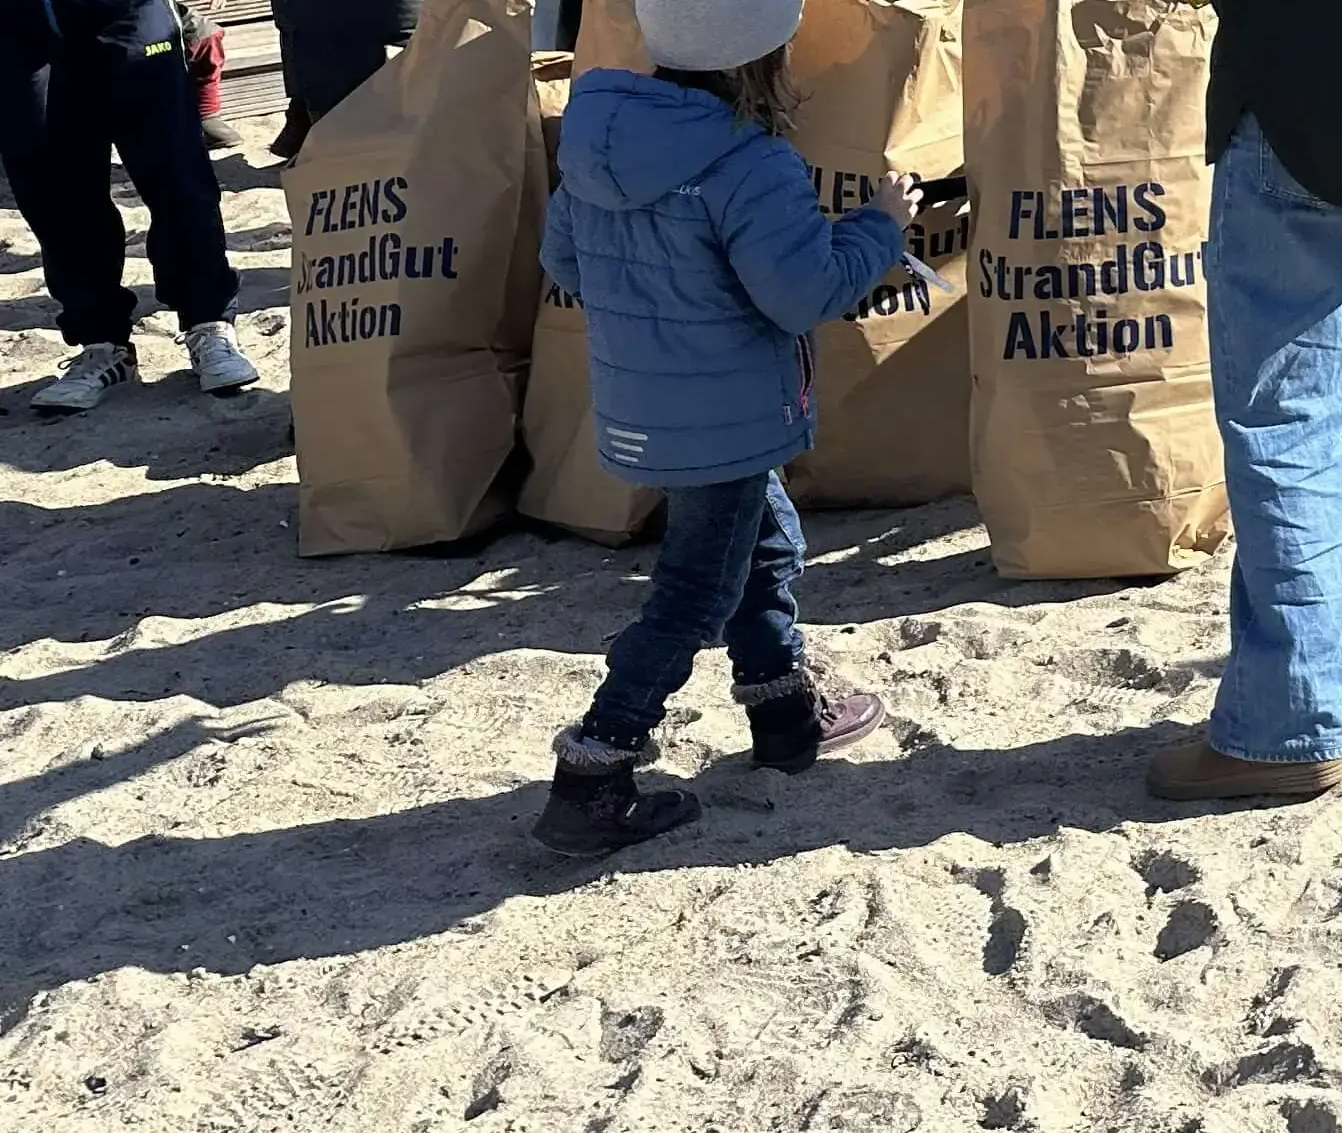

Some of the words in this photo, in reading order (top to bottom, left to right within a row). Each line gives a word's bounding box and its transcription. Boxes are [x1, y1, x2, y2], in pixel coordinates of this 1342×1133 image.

[145, 41, 172, 56] JAKO
[305, 176, 408, 236] FLENS
[1008, 182, 1166, 240] FLENS
[305, 298, 401, 348] Aktion
[1003, 310, 1173, 360] Aktion
